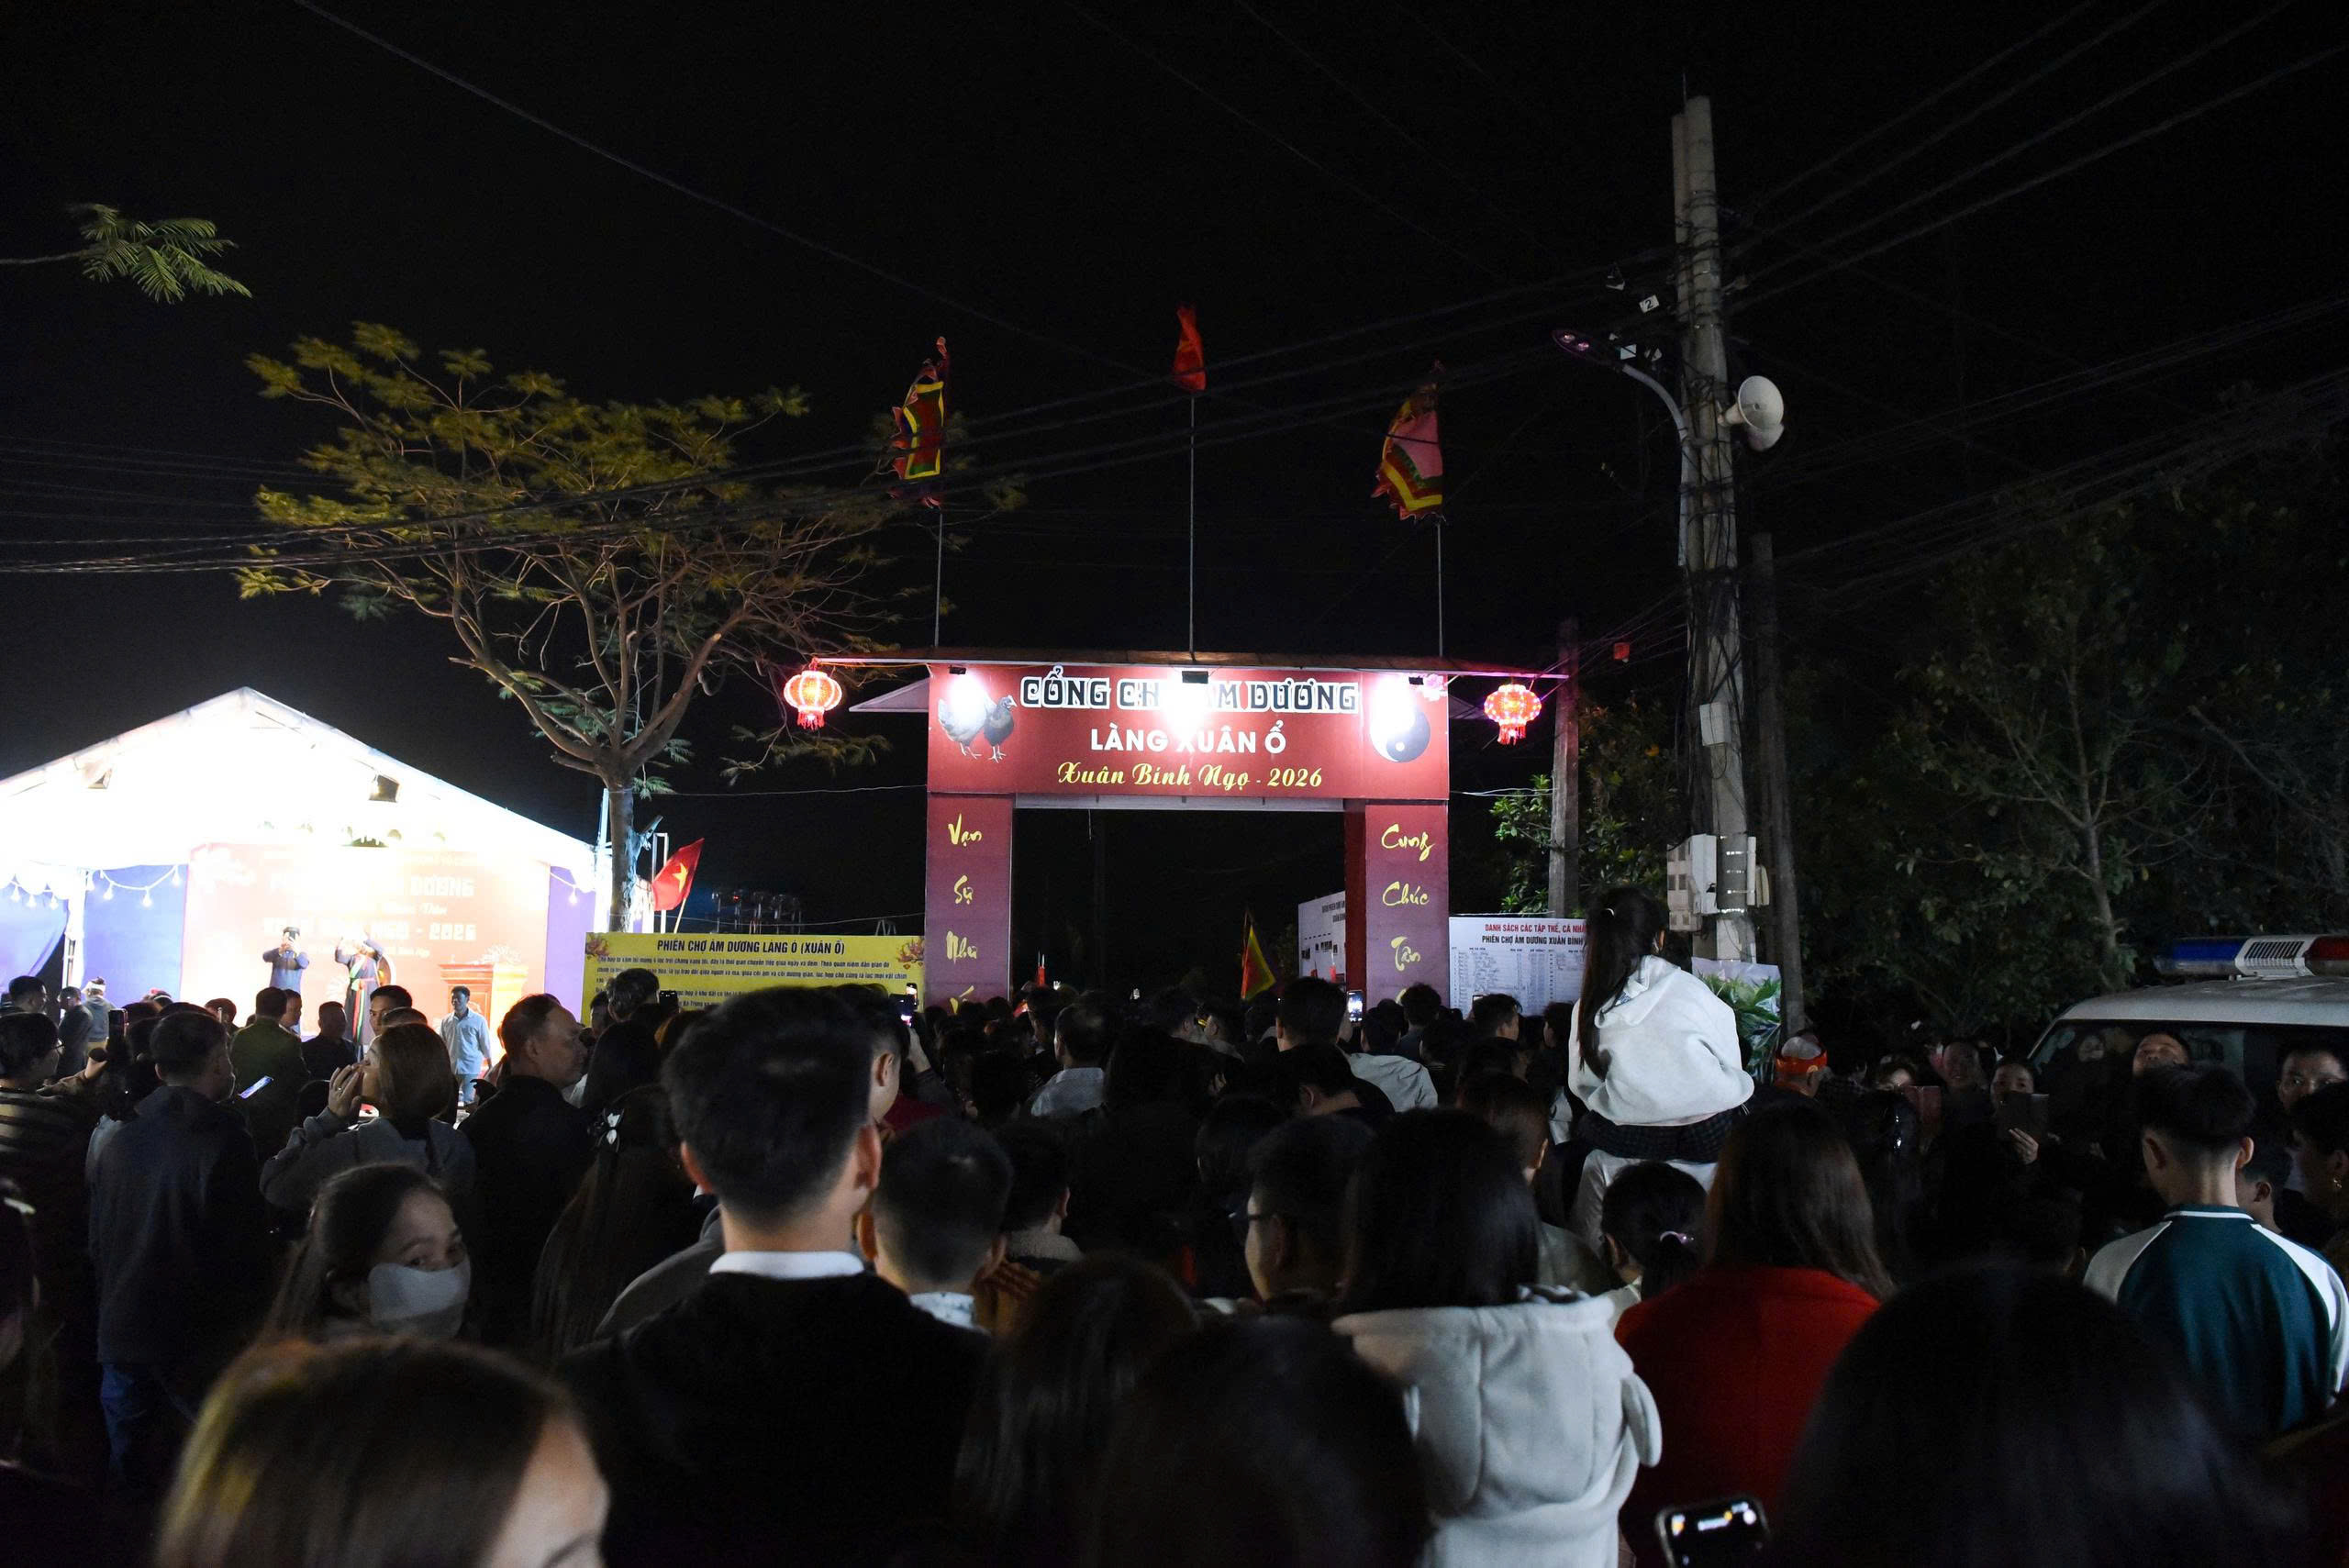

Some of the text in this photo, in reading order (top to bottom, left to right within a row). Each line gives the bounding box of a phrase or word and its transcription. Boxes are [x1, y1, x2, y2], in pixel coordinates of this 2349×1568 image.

[1644, 299, 1653, 308] 2
[1021, 667, 1108, 707] CỔNG
[1250, 679, 1357, 712] DƯƠNG
[1091, 722, 1169, 751] LÀNG
[1264, 720, 1286, 754] Ổ
[1058, 762, 1125, 784] Xuân
[1198, 764, 1251, 791] Ngọ
[1267, 767, 1322, 787] 2026
[948, 813, 983, 847] Vạn
[1381, 823, 1435, 862] Cung
[1383, 881, 1430, 906] Chúc
[1482, 934, 1499, 943] PHIÊN
[1501, 935, 1513, 946] CHỢ
[1515, 934, 1524, 945] ÂM
[1526, 935, 1547, 945] DƯƠNG
[1549, 935, 1566, 945] XUÂN
[1485, 924, 1501, 932] DANH
[1503, 923, 1519, 932] SÁCH
[1520, 923, 1532, 932] CÁC
[1534, 923, 1546, 934] TẬP
[1563, 923, 1571, 933] CÁ
[657, 939, 685, 951] PHIÊN
[688, 939, 707, 954] CHỢ
[709, 938, 725, 952] ÂM
[727, 940, 760, 952] DƯƠNG
[763, 940, 788, 953] LÀNG
[946, 930, 977, 964] Như
[1390, 936, 1421, 972] Tân
